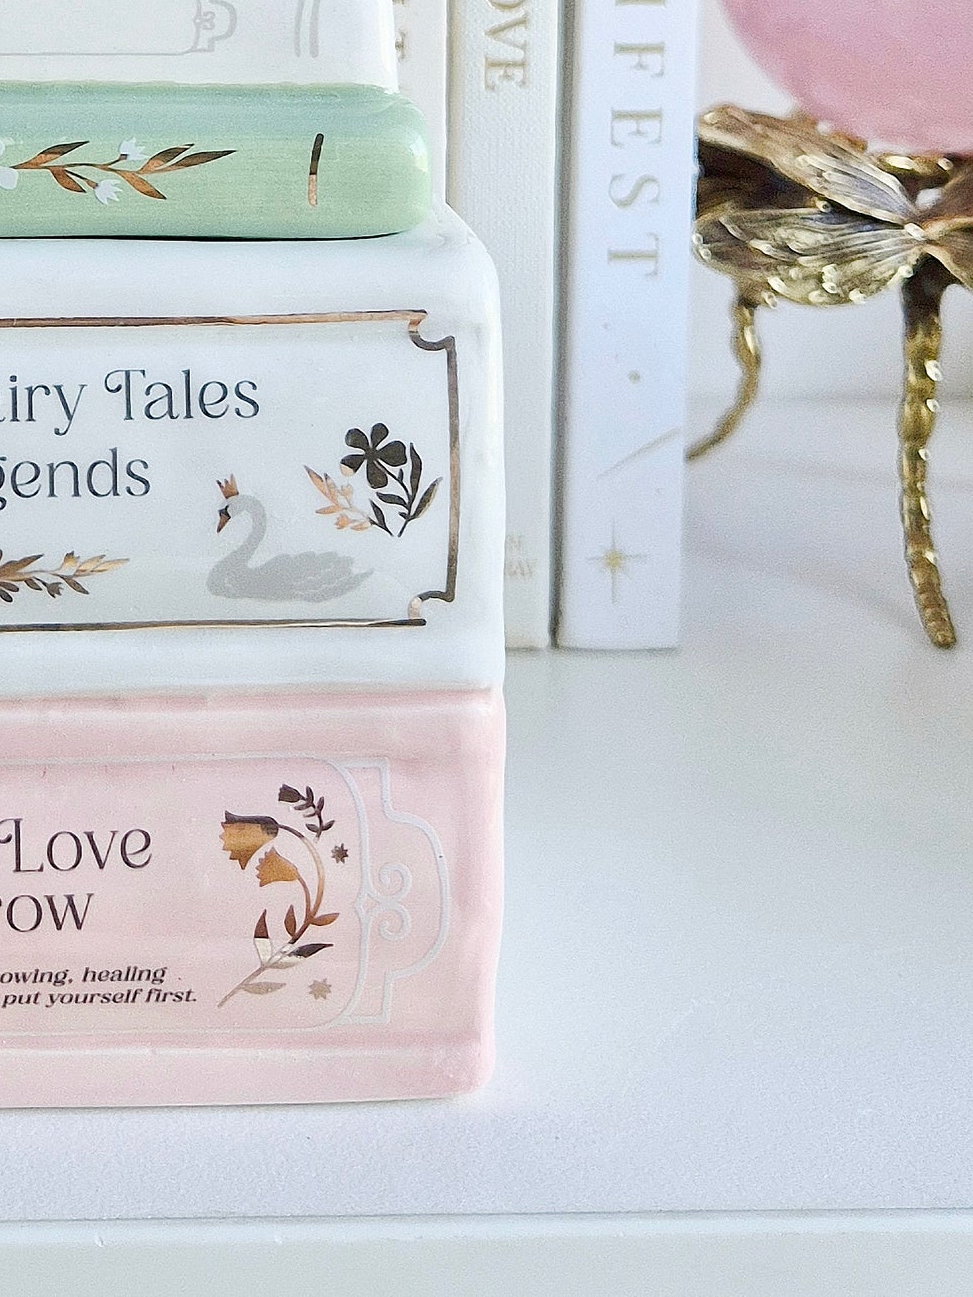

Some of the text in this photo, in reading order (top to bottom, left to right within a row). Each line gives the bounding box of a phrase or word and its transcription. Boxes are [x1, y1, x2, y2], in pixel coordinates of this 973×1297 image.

[104, 368, 260, 421] Tales
[82, 965, 168, 985] healing
[1, 990, 43, 1009] put
[45, 987, 144, 1009] yourself
[144, 987, 198, 1003] first.
